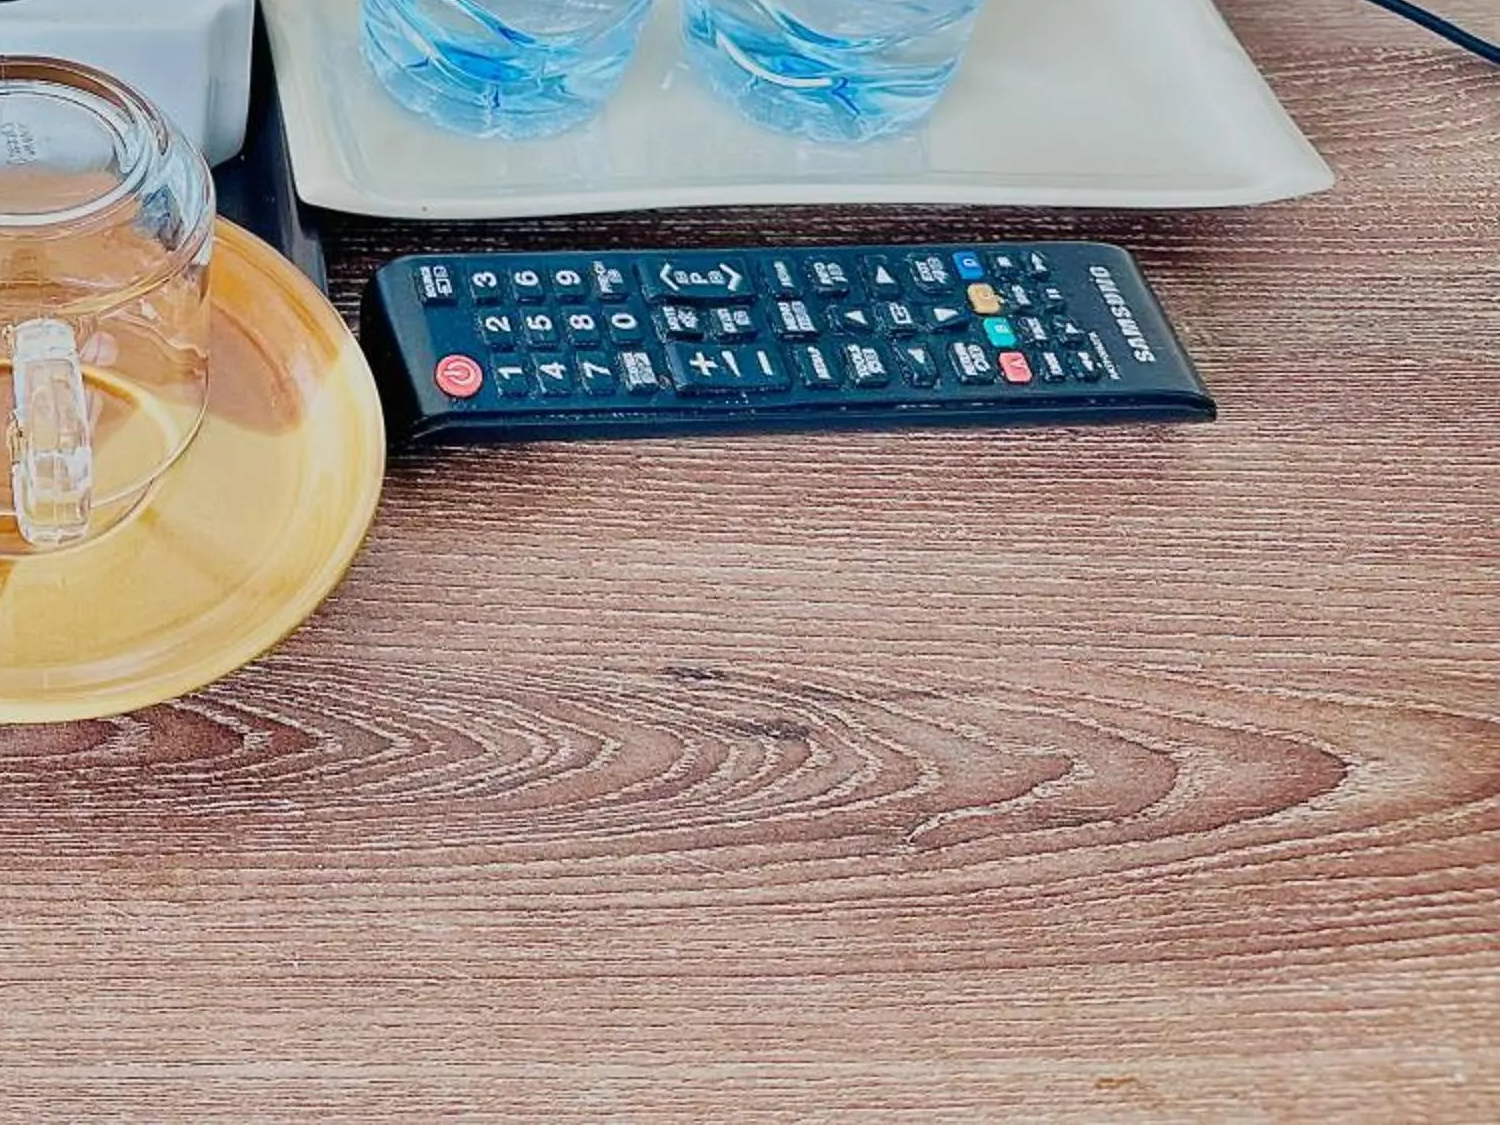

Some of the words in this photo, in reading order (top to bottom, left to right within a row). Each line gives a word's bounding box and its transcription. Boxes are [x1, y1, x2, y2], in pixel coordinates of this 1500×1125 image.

[471, 270, 498, 288] 3
[515, 269, 540, 287] 6
[555, 269, 581, 286] 9
[526, 315, 553, 331] 5
[569, 313, 595, 330] 8
[611, 312, 638, 330] 0
[1089, 266, 1156, 363] SAMSUNG
[485, 315, 512, 333] 2
[498, 365, 524, 380] 1
[539, 361, 567, 380] 4
[582, 360, 613, 379] 7
